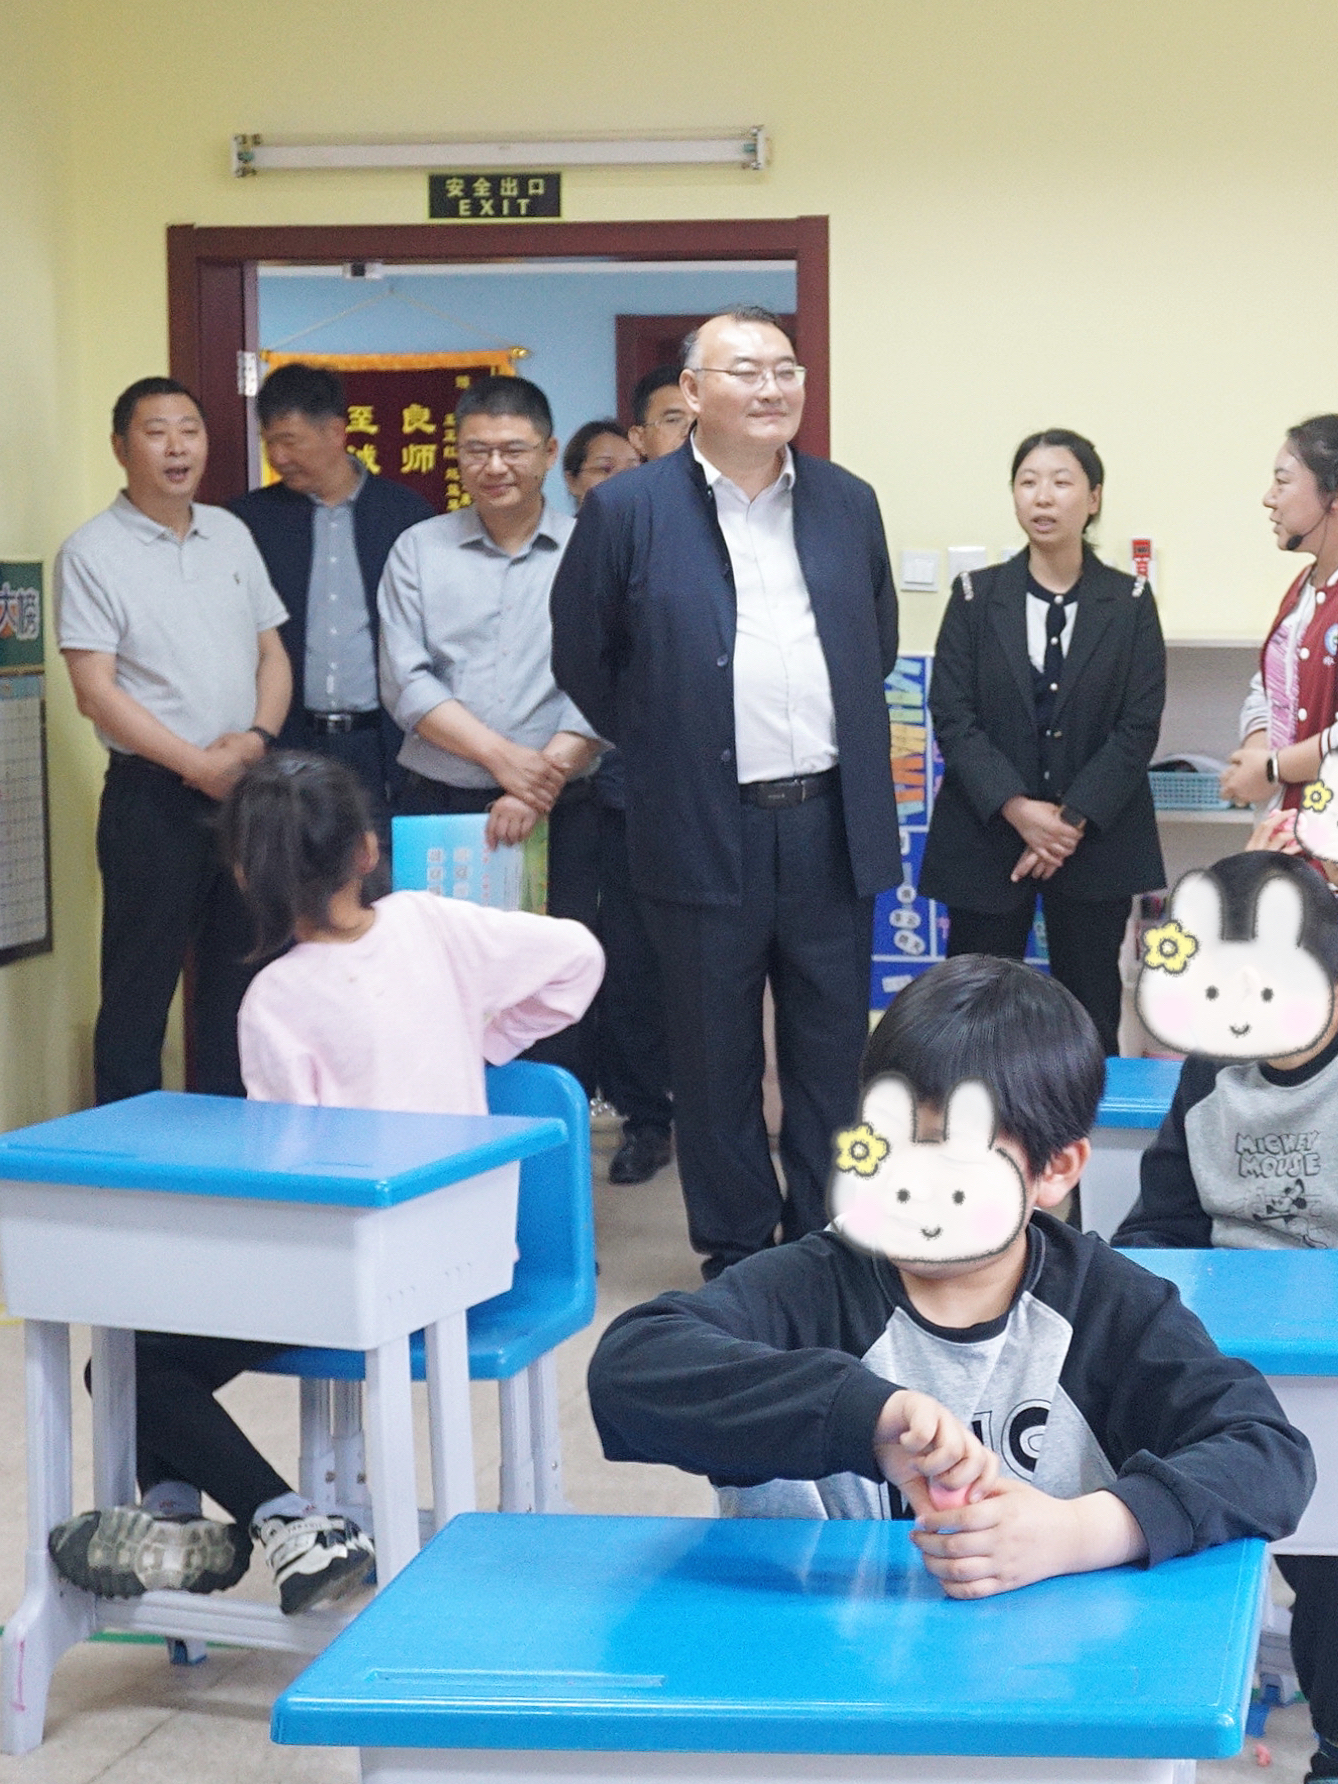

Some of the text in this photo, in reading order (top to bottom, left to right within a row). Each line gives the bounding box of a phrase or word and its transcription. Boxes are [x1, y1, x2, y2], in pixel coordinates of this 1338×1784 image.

[445, 177, 545, 197] 安全出口
[459, 199, 530, 216] EXIT
[1235, 1129, 1320, 1155] MICKEY
[1238, 1152, 1321, 1178] MOUSE
